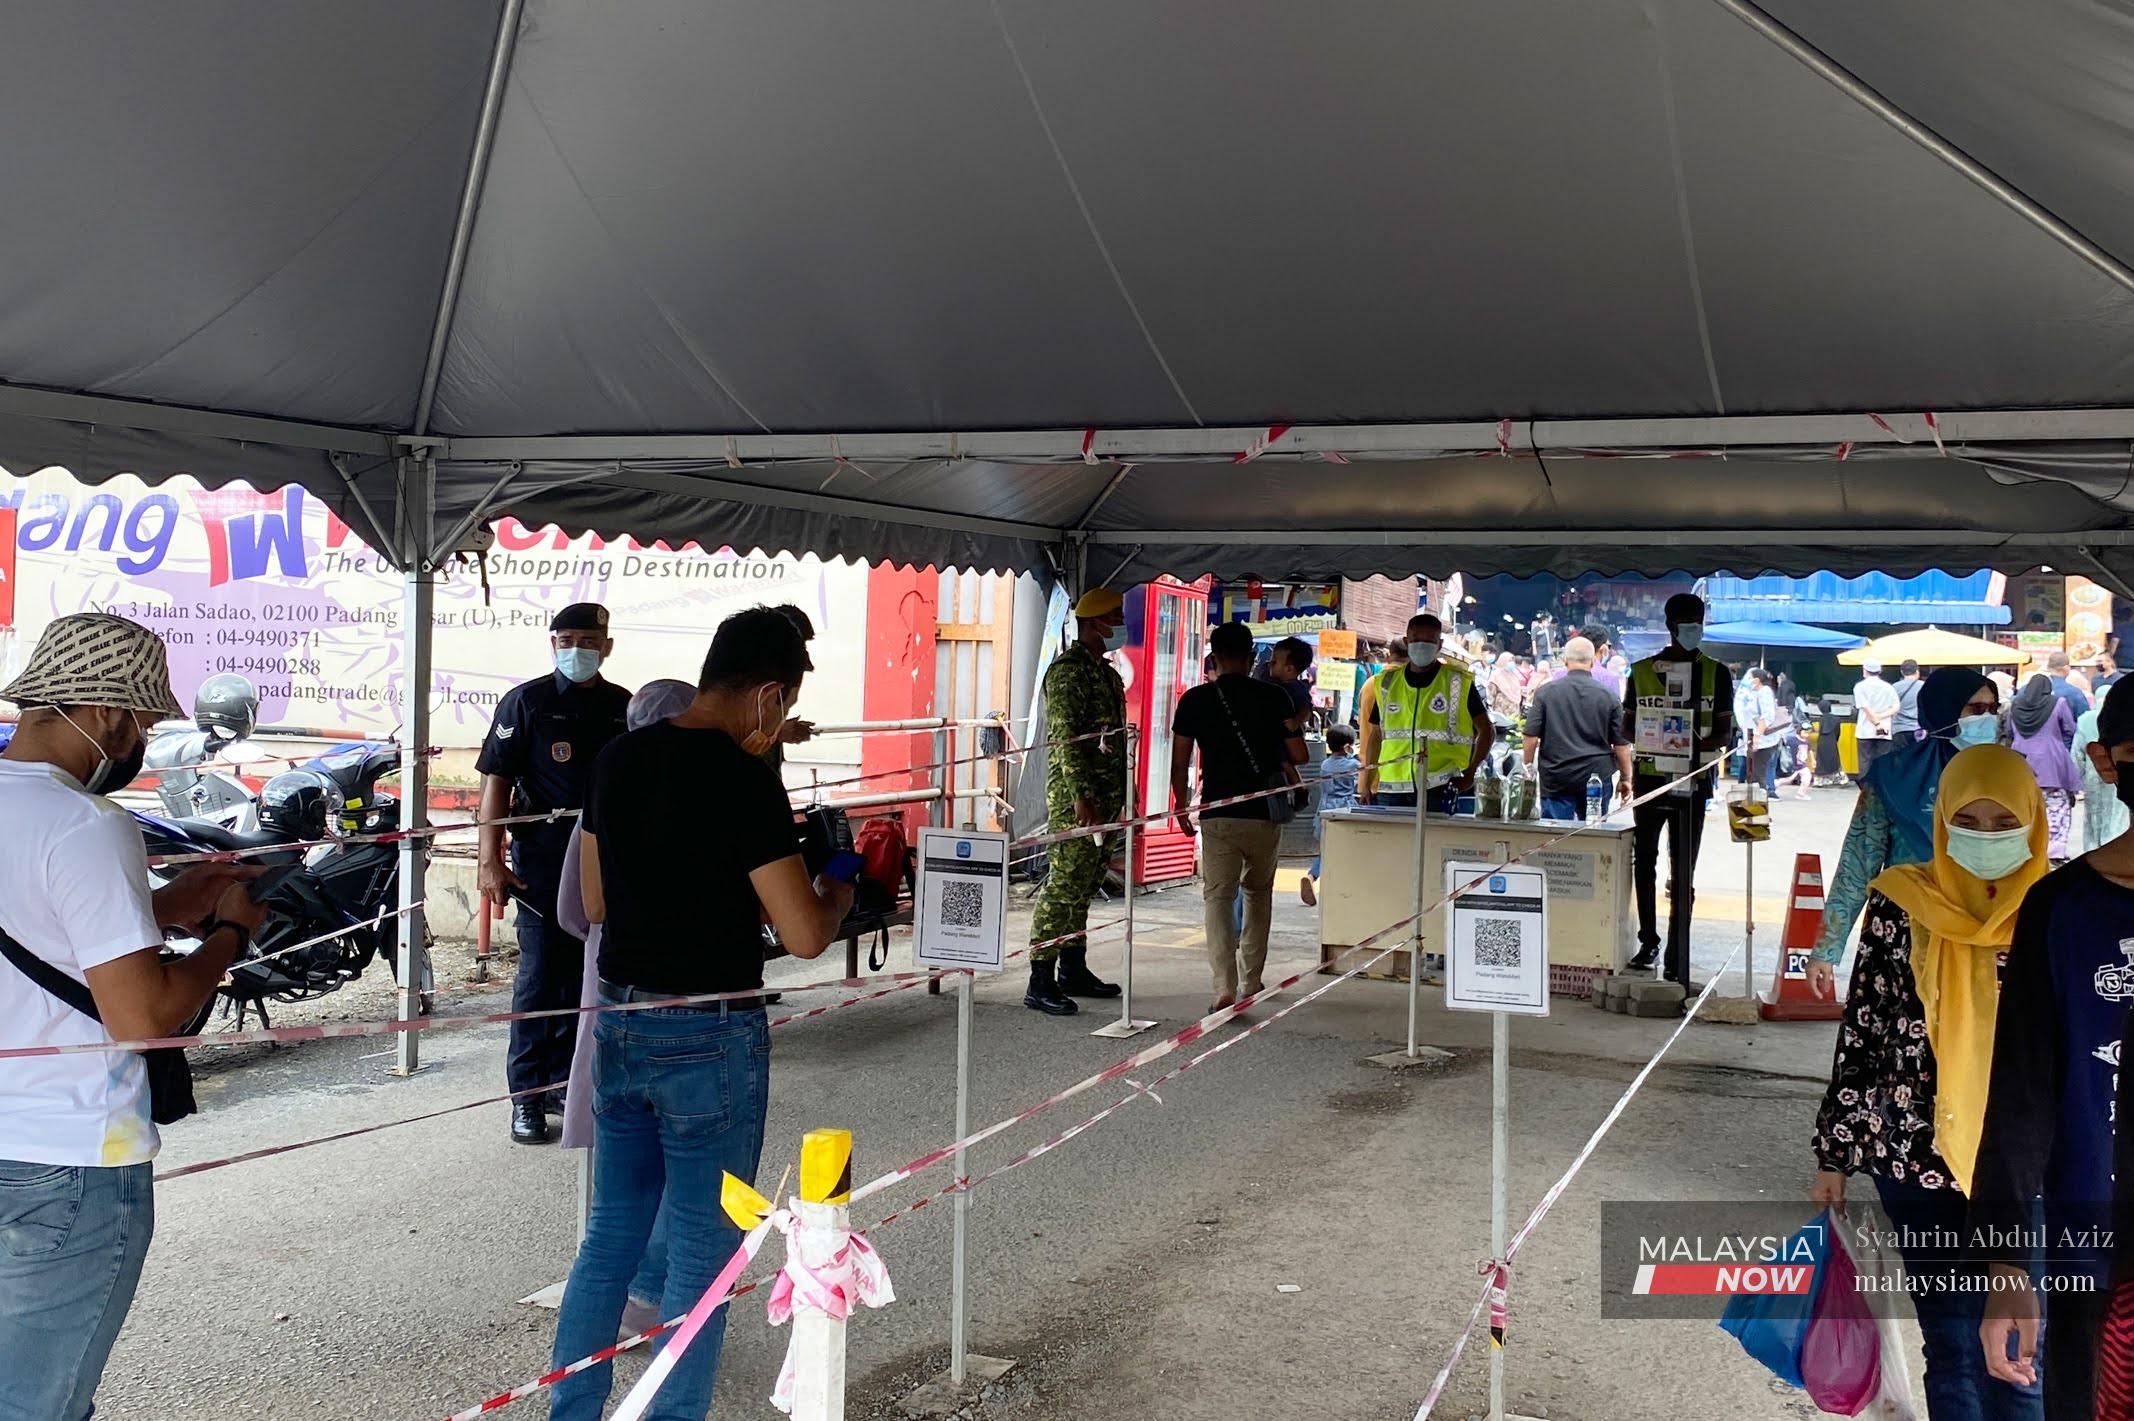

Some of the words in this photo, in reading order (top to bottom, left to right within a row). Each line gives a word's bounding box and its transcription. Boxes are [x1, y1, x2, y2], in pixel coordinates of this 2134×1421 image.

[0, 489, 179, 576] ang
[325, 552, 367, 573] The
[489, 554, 613, 582] Shopping
[622, 556, 786, 579] Destination
[90, 600, 122, 617] No.
[129, 602, 138, 617] 3
[143, 602, 189, 618] Jalan
[195, 603, 256, 622] Sadao,
[263, 604, 319, 621] 02100
[325, 606, 398, 628] Padang
[431, 611, 457, 625] sar
[463, 608, 501, 630] (U),
[509, 610, 555, 626] Perli
[216, 629, 320, 647] 04-9490371
[216, 655, 321, 675] 04-9490288
[258, 682, 499, 707] padangtrade@gil.com
